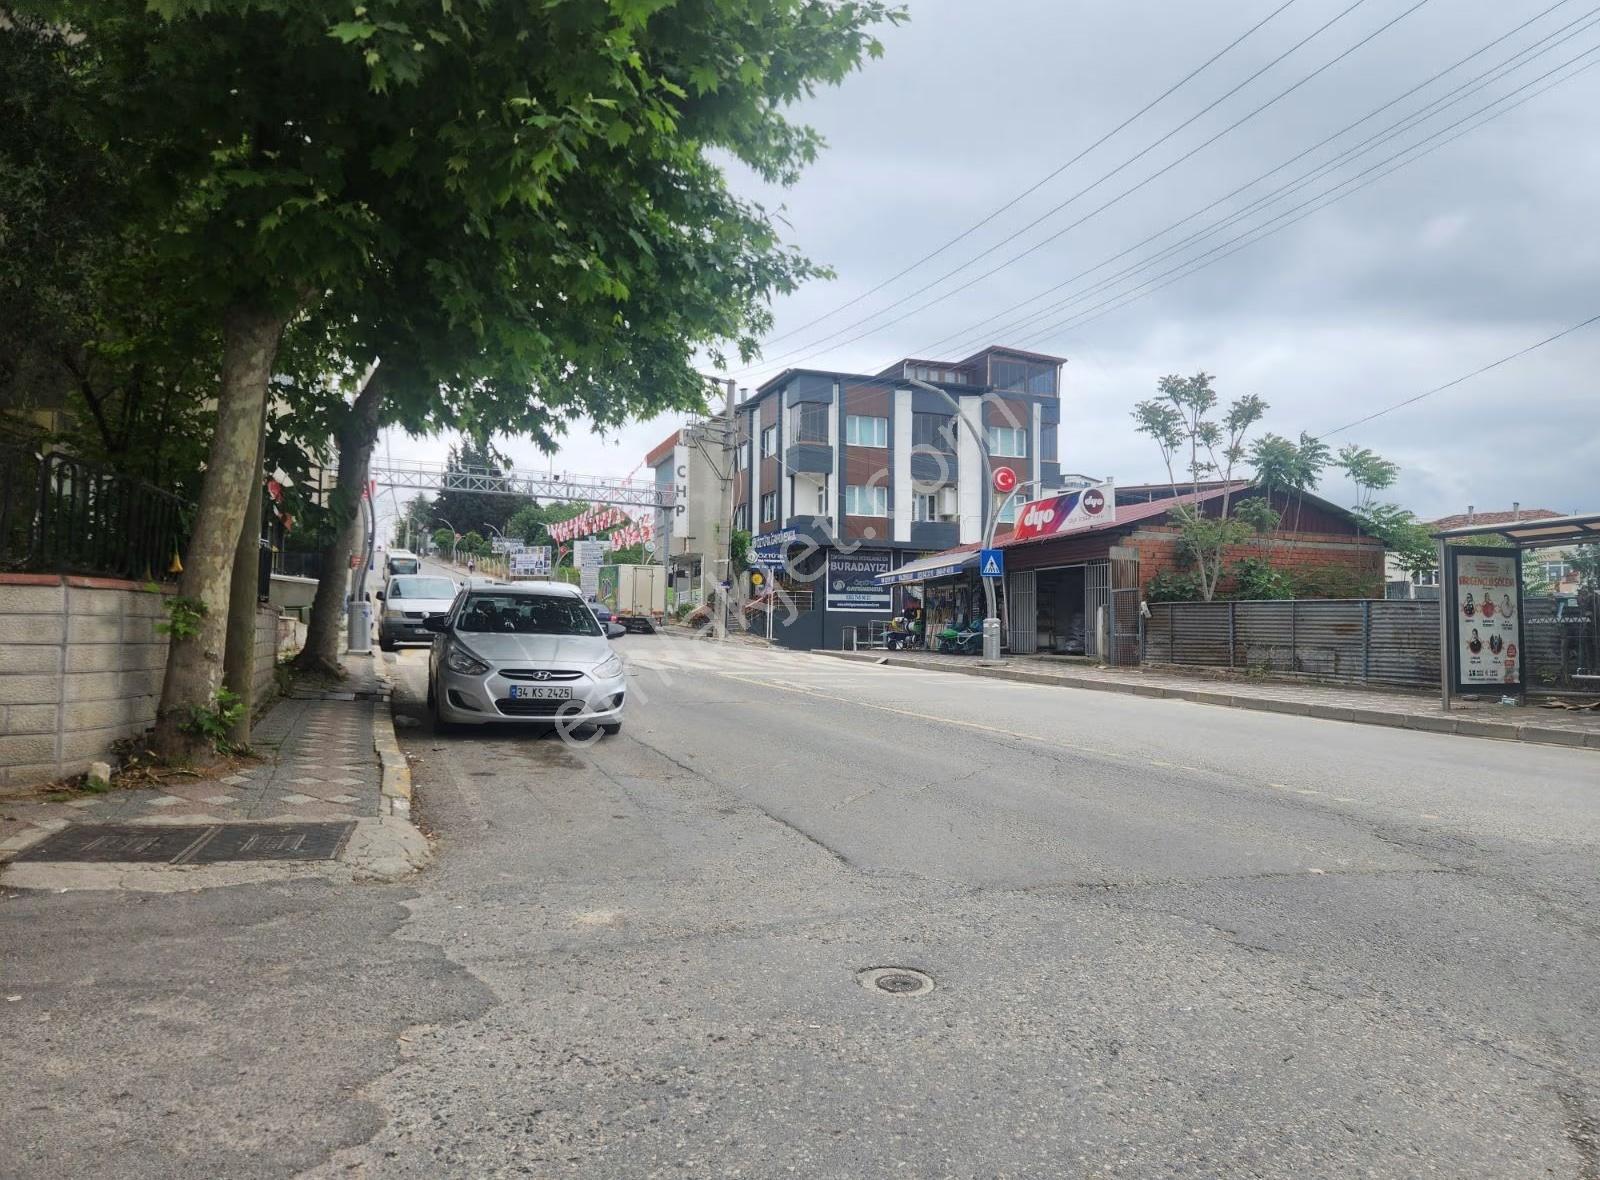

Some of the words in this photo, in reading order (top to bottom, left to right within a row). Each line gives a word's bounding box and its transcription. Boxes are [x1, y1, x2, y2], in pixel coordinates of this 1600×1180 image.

[676, 465, 687, 517] CHP
[1085, 496, 1104, 508] dyo
[1024, 505, 1055, 532] dyo
[517, 687, 528, 697] 34
[532, 688, 543, 698] KS
[547, 689, 569, 698] 2425
